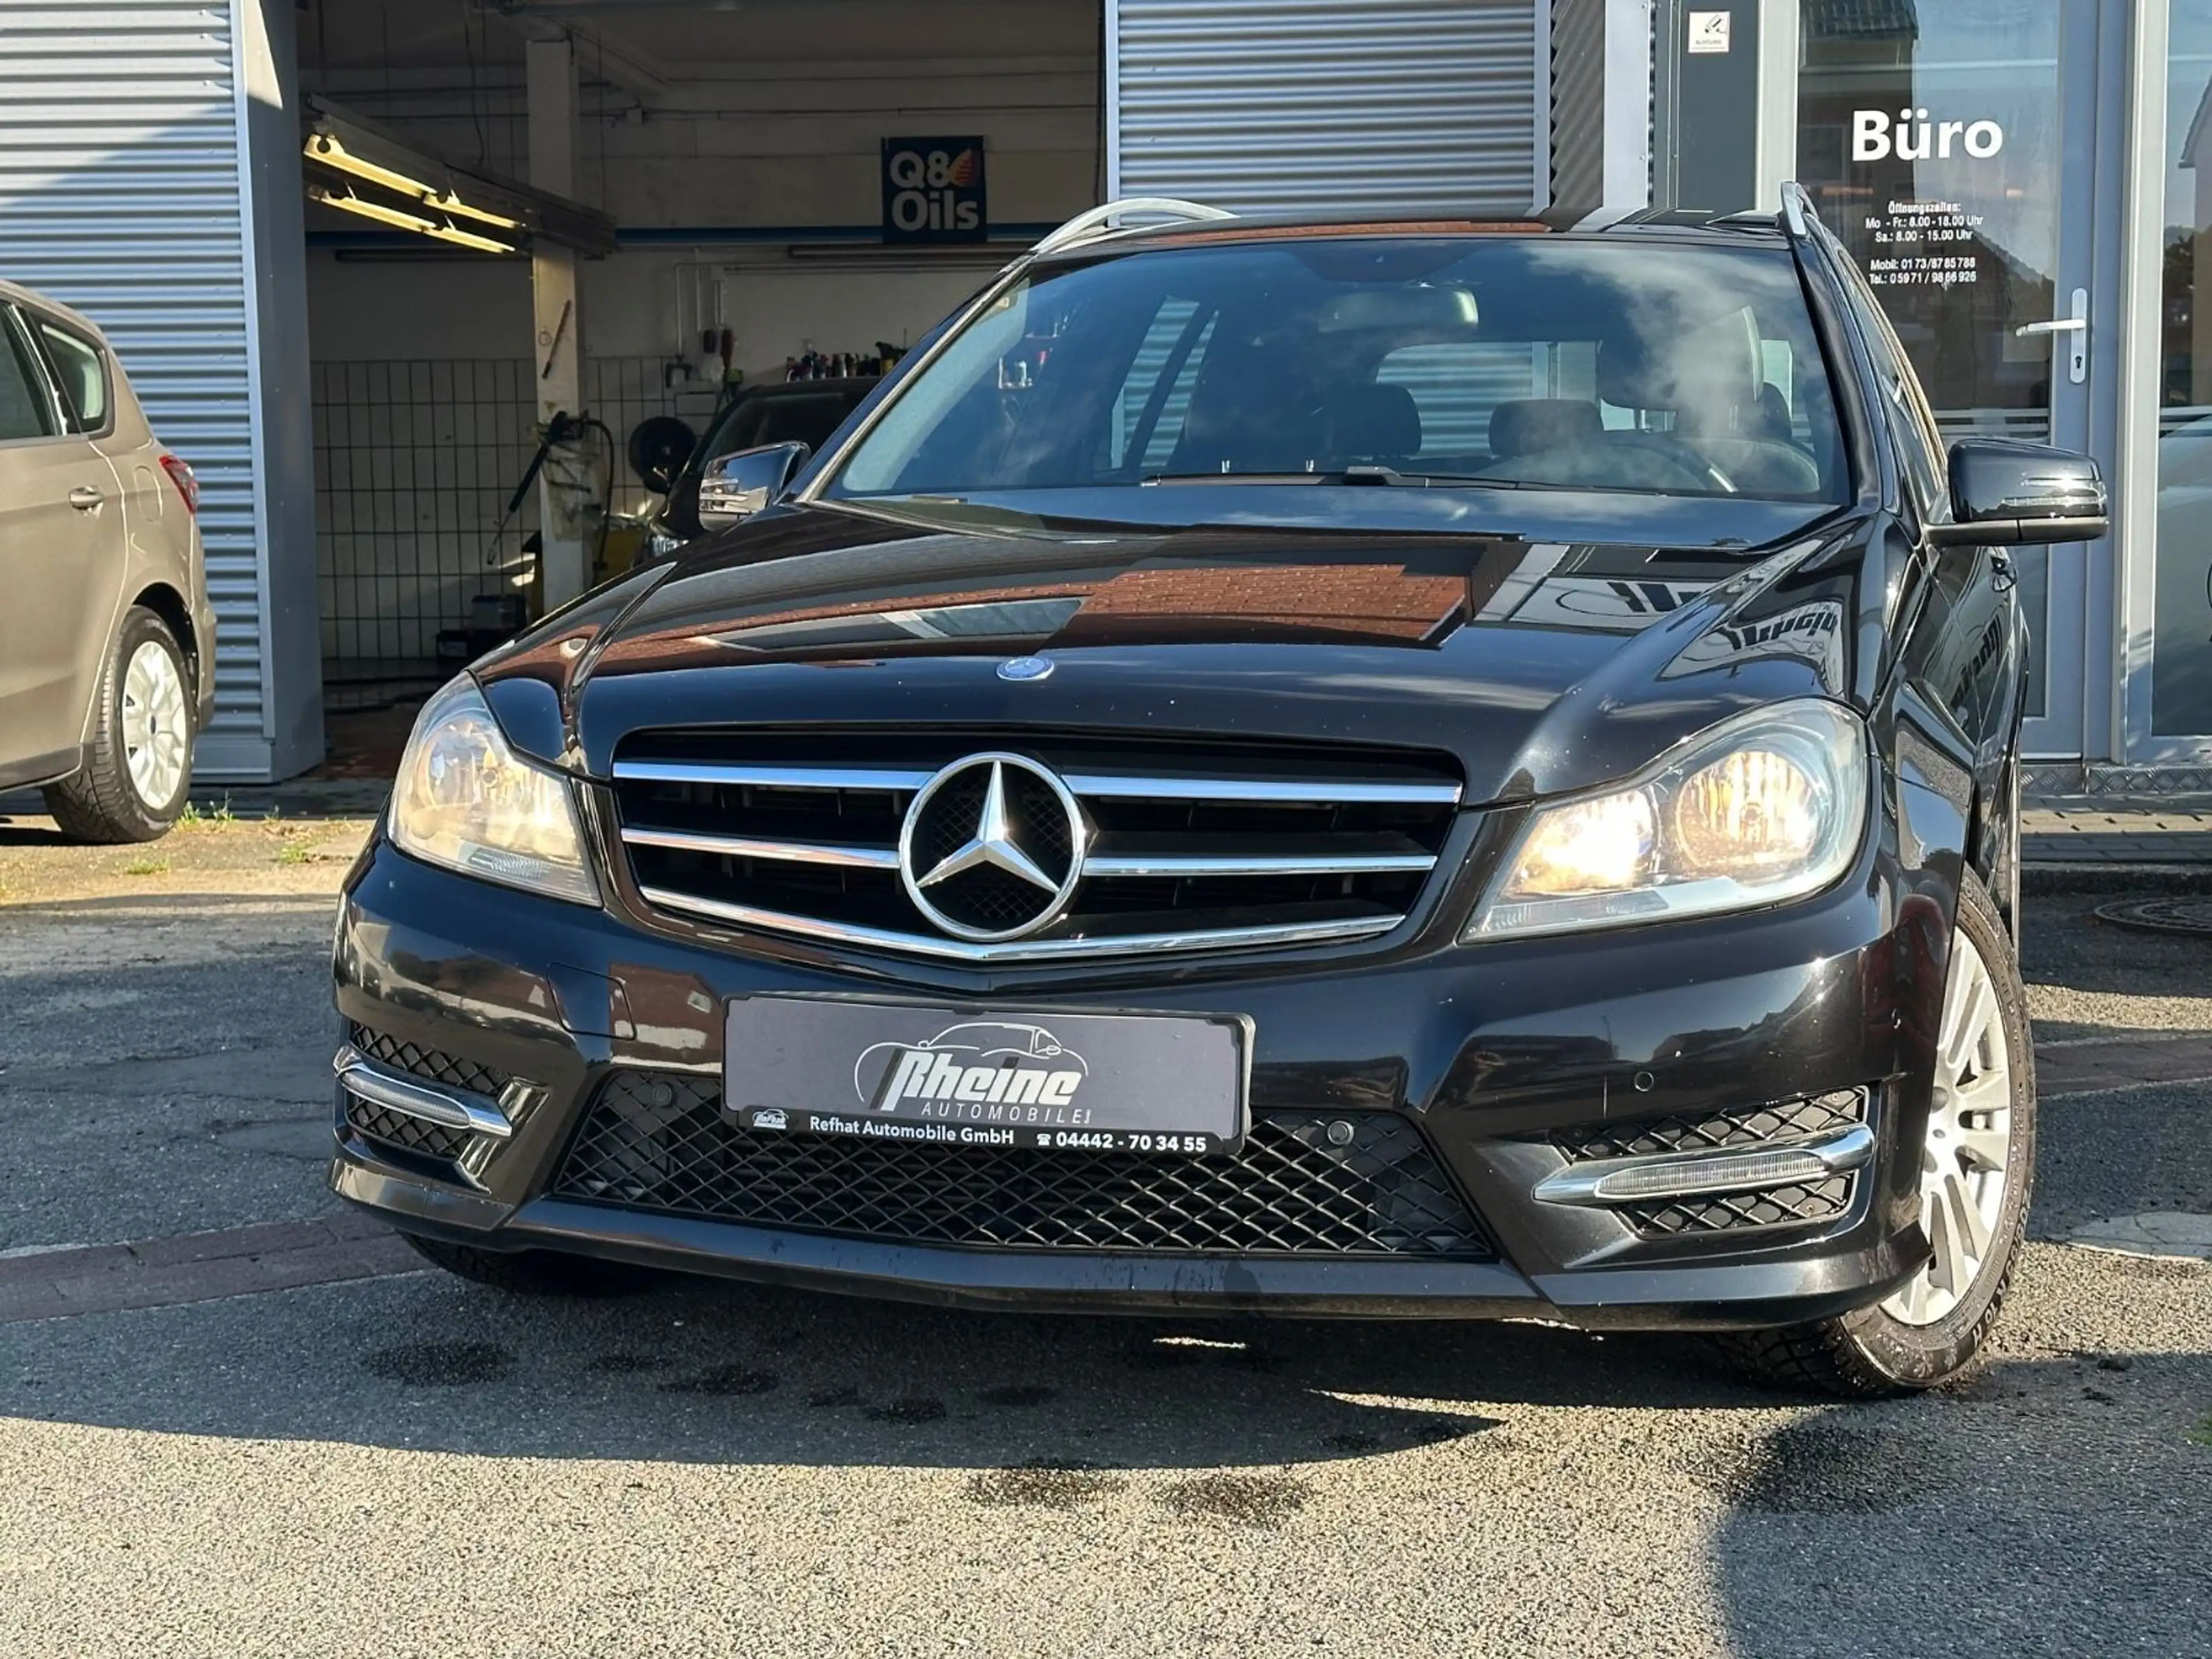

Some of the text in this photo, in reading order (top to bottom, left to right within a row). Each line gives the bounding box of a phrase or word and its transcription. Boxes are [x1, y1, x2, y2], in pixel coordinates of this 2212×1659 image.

[1852, 108, 2003, 161] Büro
[890, 150, 951, 188] Q8
[892, 190, 979, 232] Oils
[1865, 217, 1881, 229] Mo
[1966, 214, 1984, 226] Uhr
[1956, 229, 1974, 240] Uhr
[1870, 259, 1899, 271] Mobil:
[809, 1115, 860, 1135] Refhat
[862, 1120, 956, 1142] Automobile
[960, 1127, 1015, 1145] GmbH
[1056, 1132, 1113, 1149] 04442
[1128, 1135, 1152, 1150] 70
[1156, 1137, 1179, 1152] 34
[1183, 1137, 1207, 1153] 55
